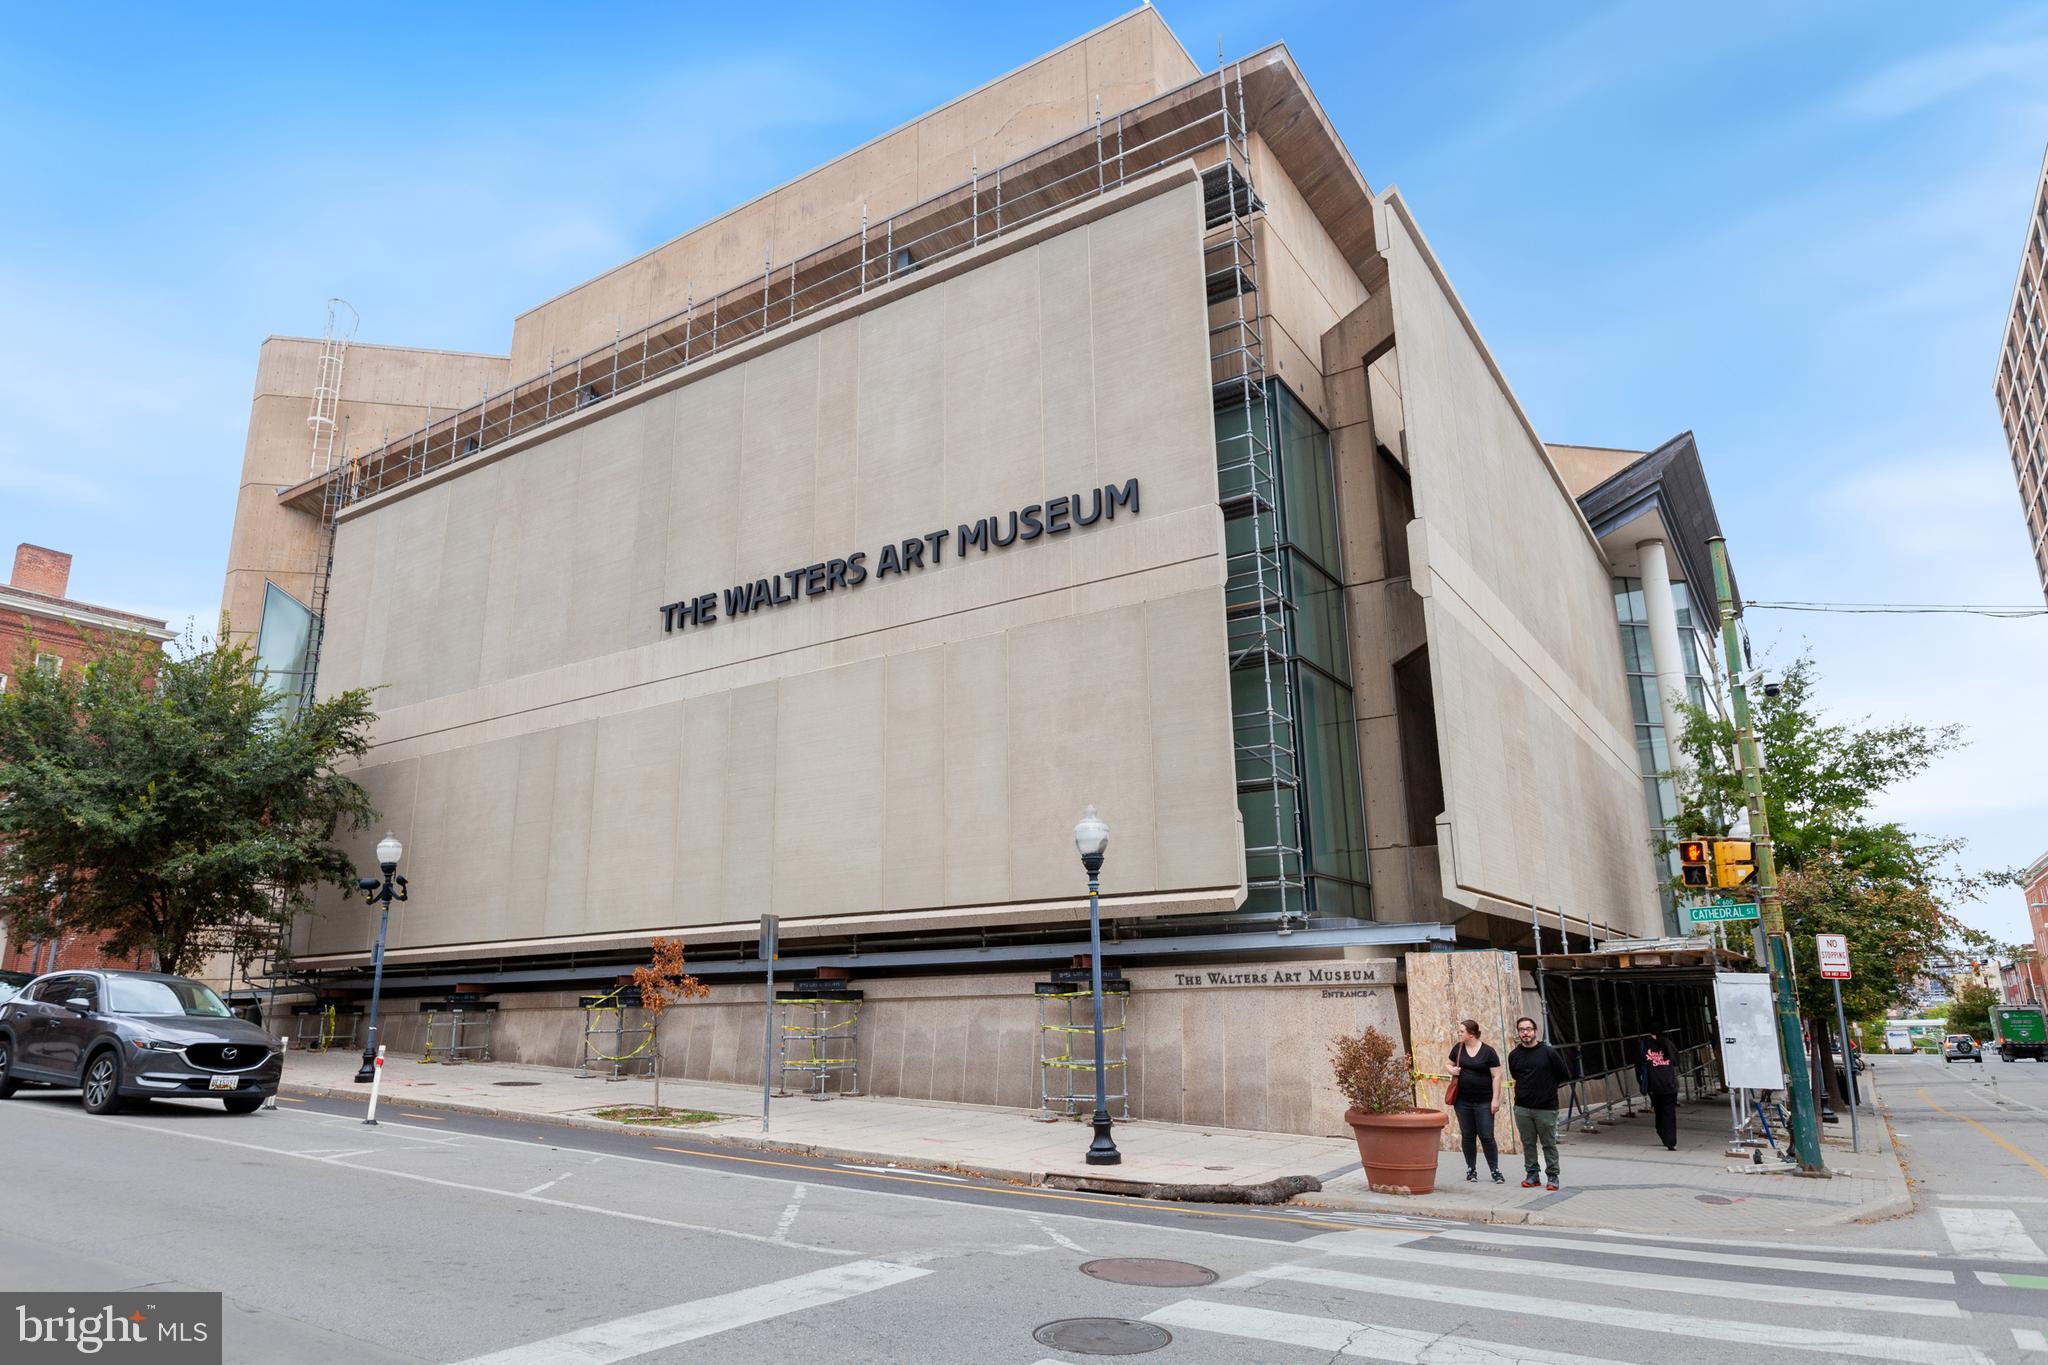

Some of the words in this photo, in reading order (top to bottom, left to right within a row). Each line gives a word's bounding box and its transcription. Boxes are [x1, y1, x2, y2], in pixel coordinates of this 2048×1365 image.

[660, 592, 717, 633] THE
[724, 552, 868, 617] WALTERS
[876, 529, 949, 578] ART
[957, 478, 1140, 557] MUSEUM
[1692, 907, 1745, 920] CATHEDRAL
[1826, 939, 1838, 948] NO
[1821, 951, 1847, 960] STOPPING
